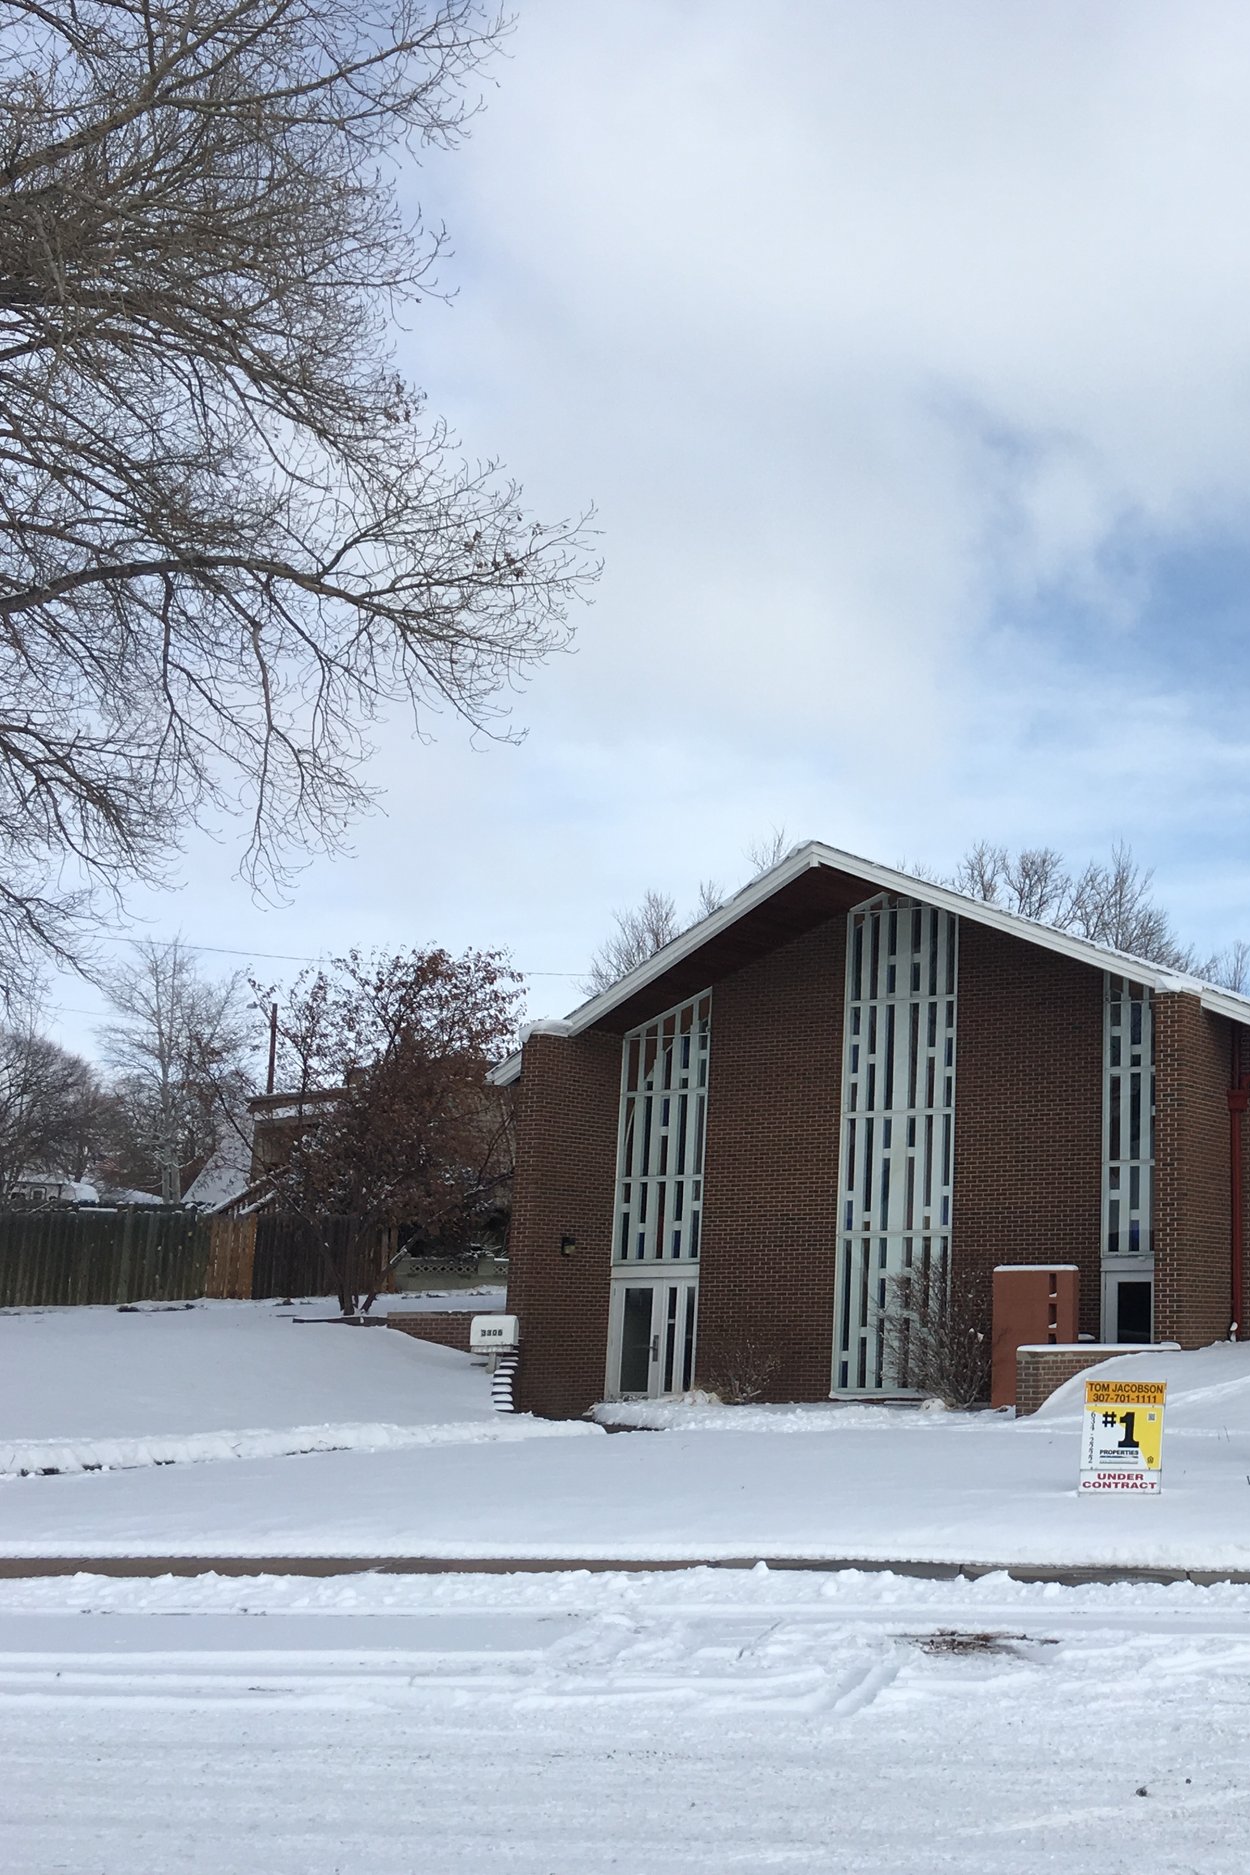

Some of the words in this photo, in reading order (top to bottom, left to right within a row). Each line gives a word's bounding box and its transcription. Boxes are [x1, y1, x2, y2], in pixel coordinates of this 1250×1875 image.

[1089, 1383, 1110, 1392] TOM
[1112, 1384, 1164, 1393] JACOBSON
[1093, 1393, 1158, 1403] 307-701-1111
[1097, 1473, 1144, 1481] UNDER
[1082, 1481, 1157, 1489] CONTRACT
